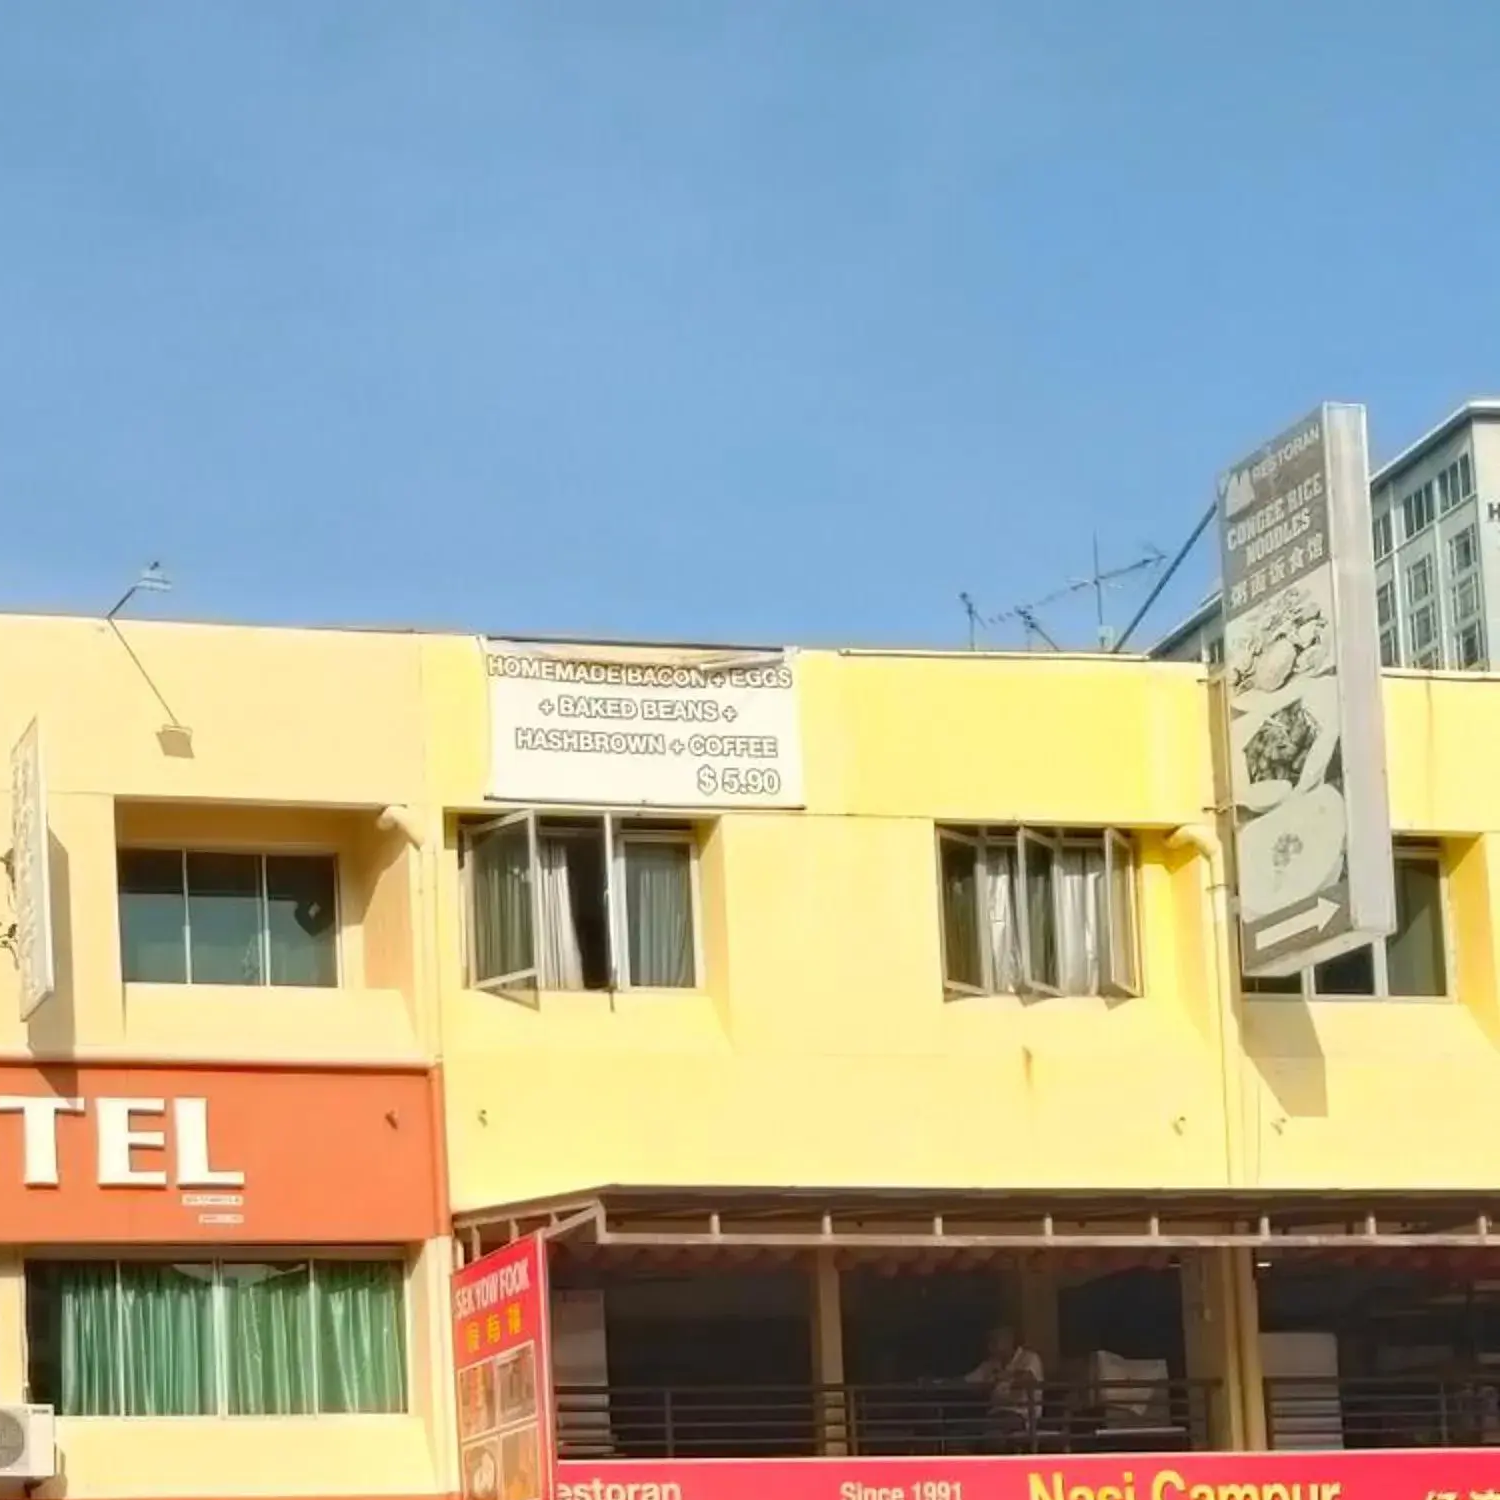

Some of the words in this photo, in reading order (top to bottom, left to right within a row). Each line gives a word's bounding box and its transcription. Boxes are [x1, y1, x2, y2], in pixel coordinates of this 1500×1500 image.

[1252, 424, 1320, 483] RESTORAN
[1227, 497, 1285, 551] CONGEE
[1287, 472, 1323, 511] RICE
[1246, 506, 1310, 567] NOODLES
[487, 655, 626, 684] HOMEMADE
[627, 666, 706, 689] BACON
[729, 668, 793, 688] EGGS
[558, 696, 638, 719] BAKED
[641, 699, 718, 721] BEANS
[515, 728, 666, 755] HASHBROWN
[688, 735, 778, 758] COFFEE
